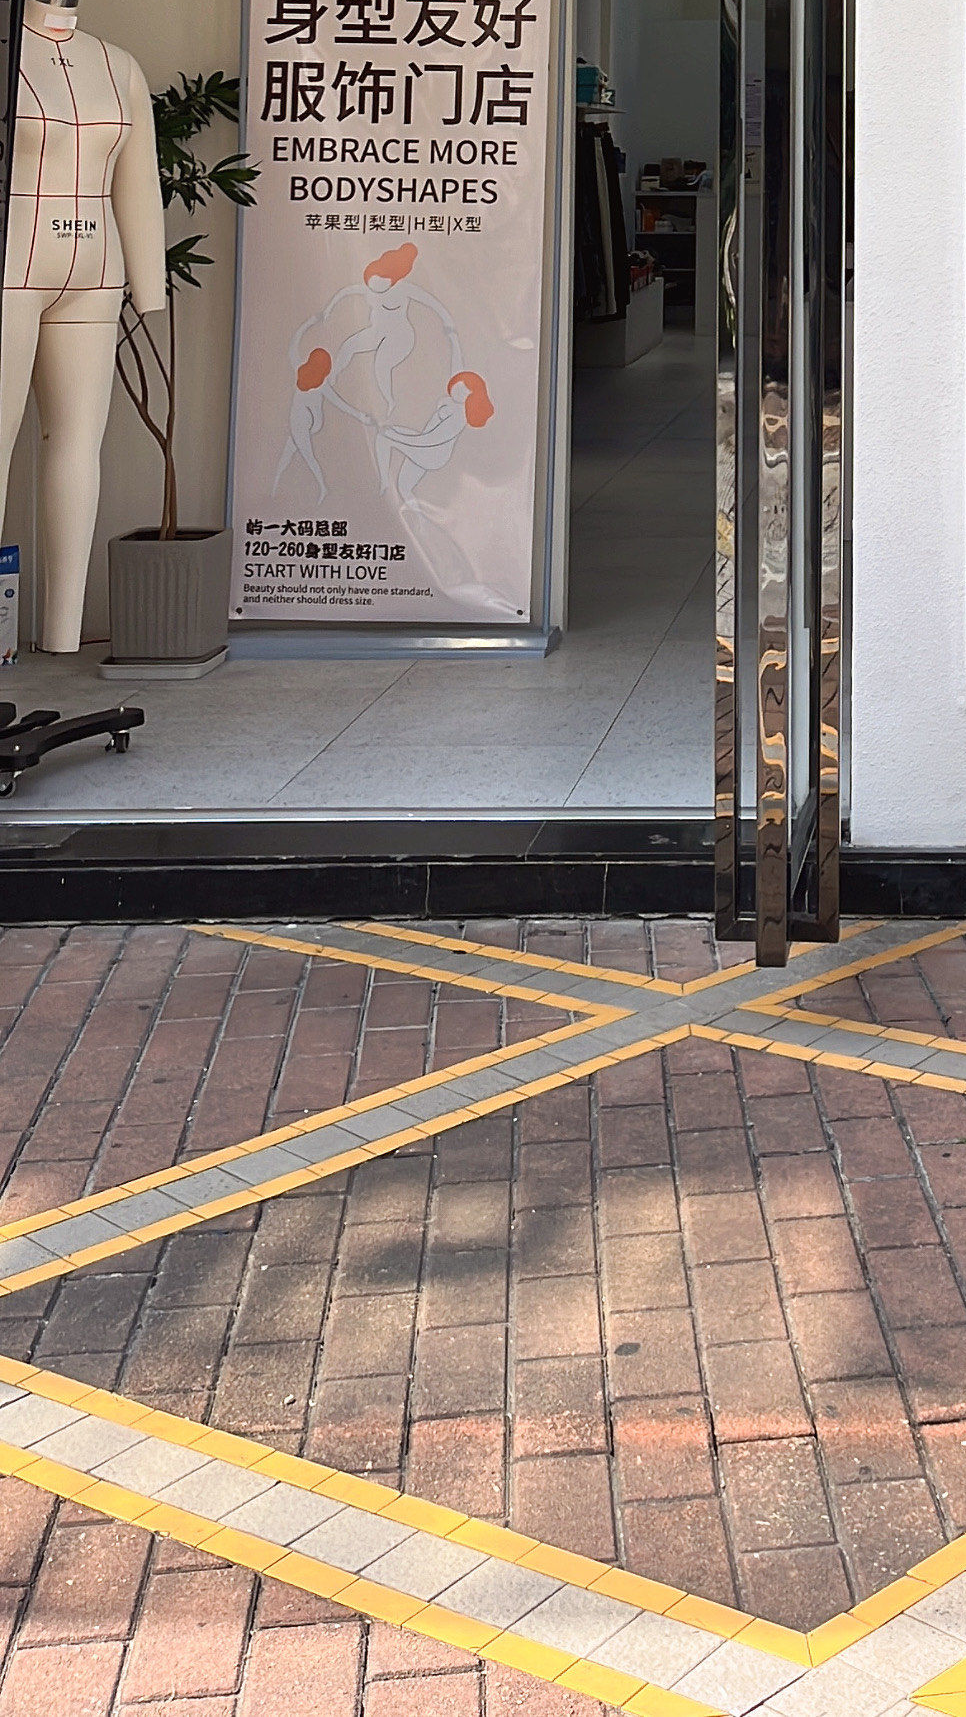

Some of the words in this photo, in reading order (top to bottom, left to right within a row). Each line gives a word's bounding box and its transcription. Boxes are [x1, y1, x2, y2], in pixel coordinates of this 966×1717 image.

[260, 60, 535, 127] 服饰门店
[271, 136, 420, 164] EMBRACE
[429, 139, 518, 165] MORE
[289, 176, 499, 204] BODYSHAPES
[51, 219, 97, 231] SHEIN
[245, 519, 348, 537] 屿一大码总部
[244, 541, 406, 561] 120-260身型友好门店
[244, 563, 296, 578] START
[300, 564, 341, 579] WITH
[346, 565, 387, 580] LOVE
[243, 584, 276, 594] Beauty
[277, 584, 308, 594] should
[309, 586, 325, 594] not
[327, 585, 347, 596] only
[348, 586, 370, 595] have
[390, 587, 434, 597] standard,
[243, 595, 260, 603] and
[262, 595, 295, 604] neither
[297, 595, 328, 604] should
[329, 596, 353, 605] dress
[355, 597, 375, 606] size.
